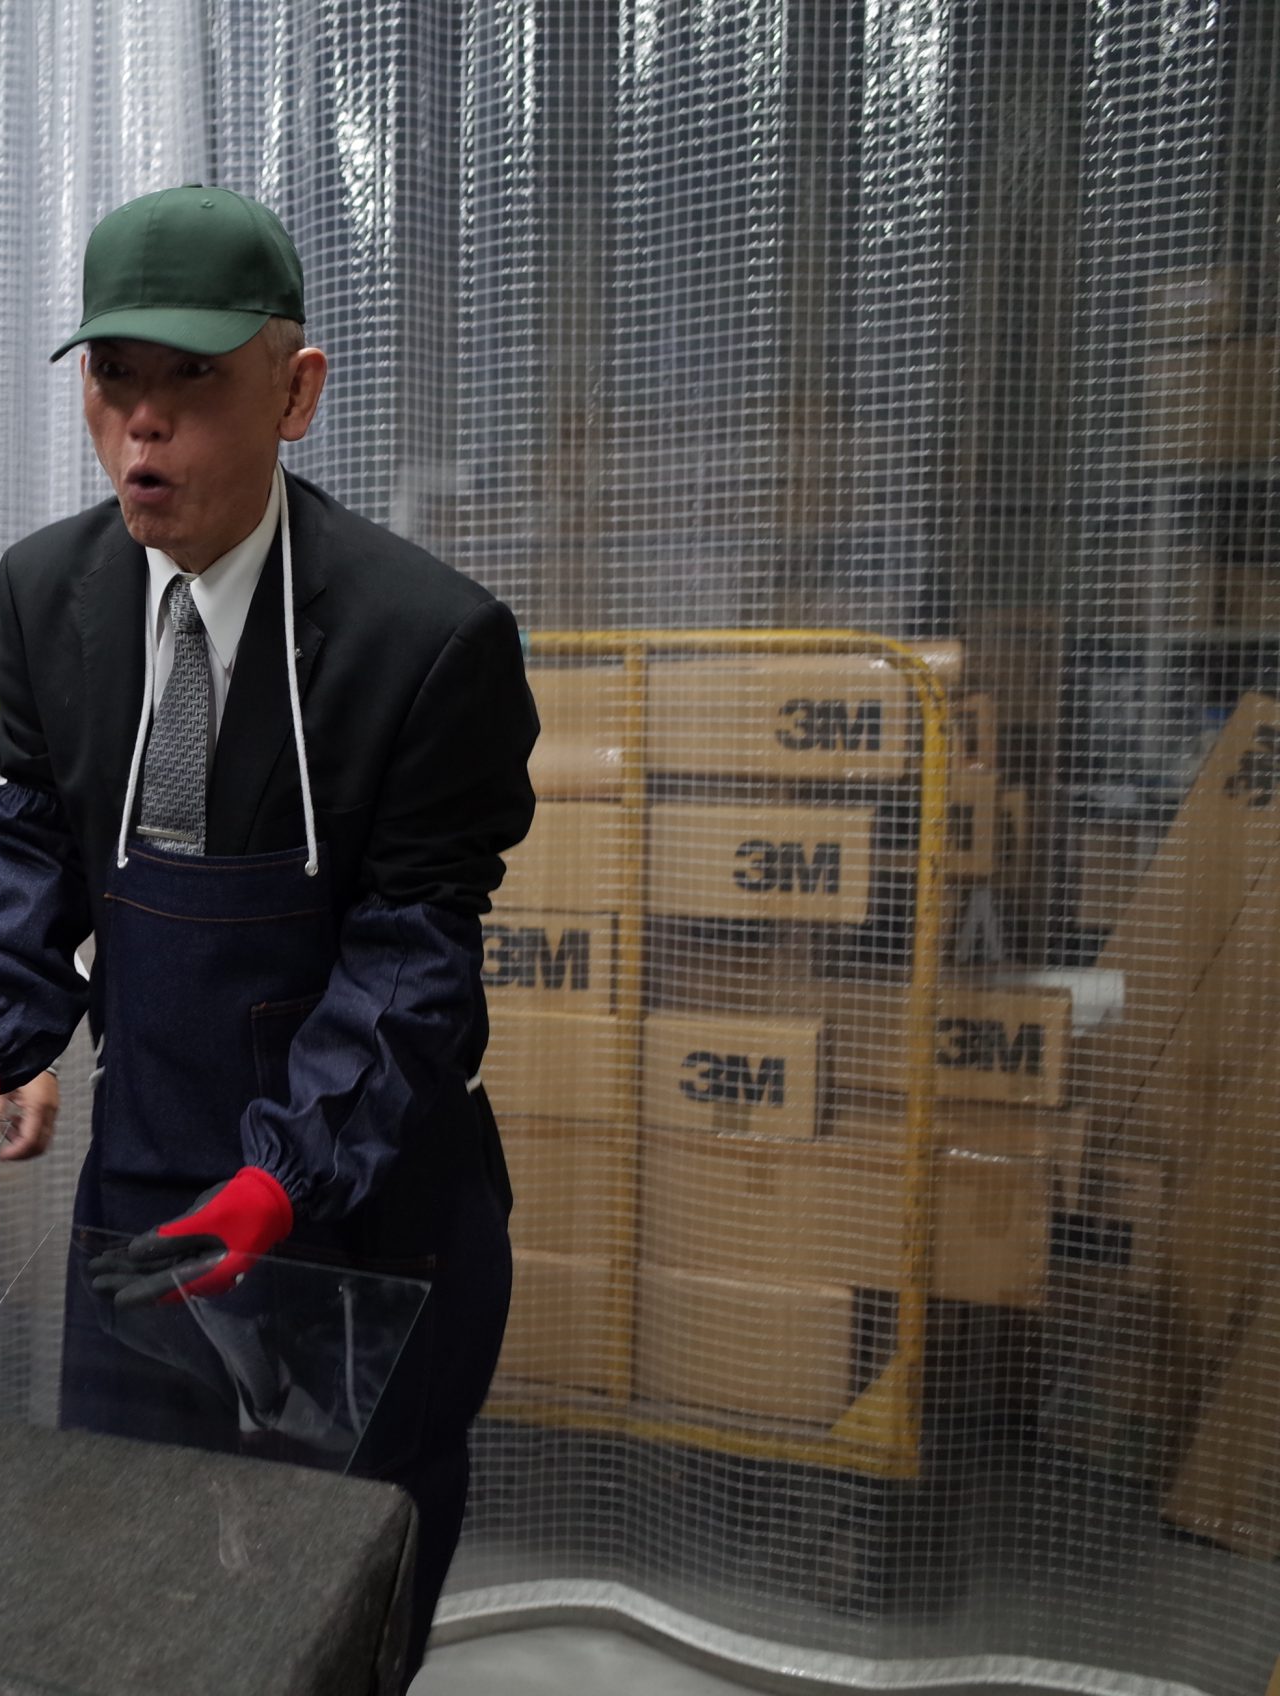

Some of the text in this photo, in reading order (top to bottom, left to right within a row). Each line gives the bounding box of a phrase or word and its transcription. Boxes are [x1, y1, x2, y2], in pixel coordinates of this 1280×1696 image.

[774, 698, 881, 752] 3M
[733, 839, 841, 894] 3M
[480, 925, 590, 990] 3M
[935, 1017, 1045, 1077] 3M
[679, 1050, 786, 1108] 3M
